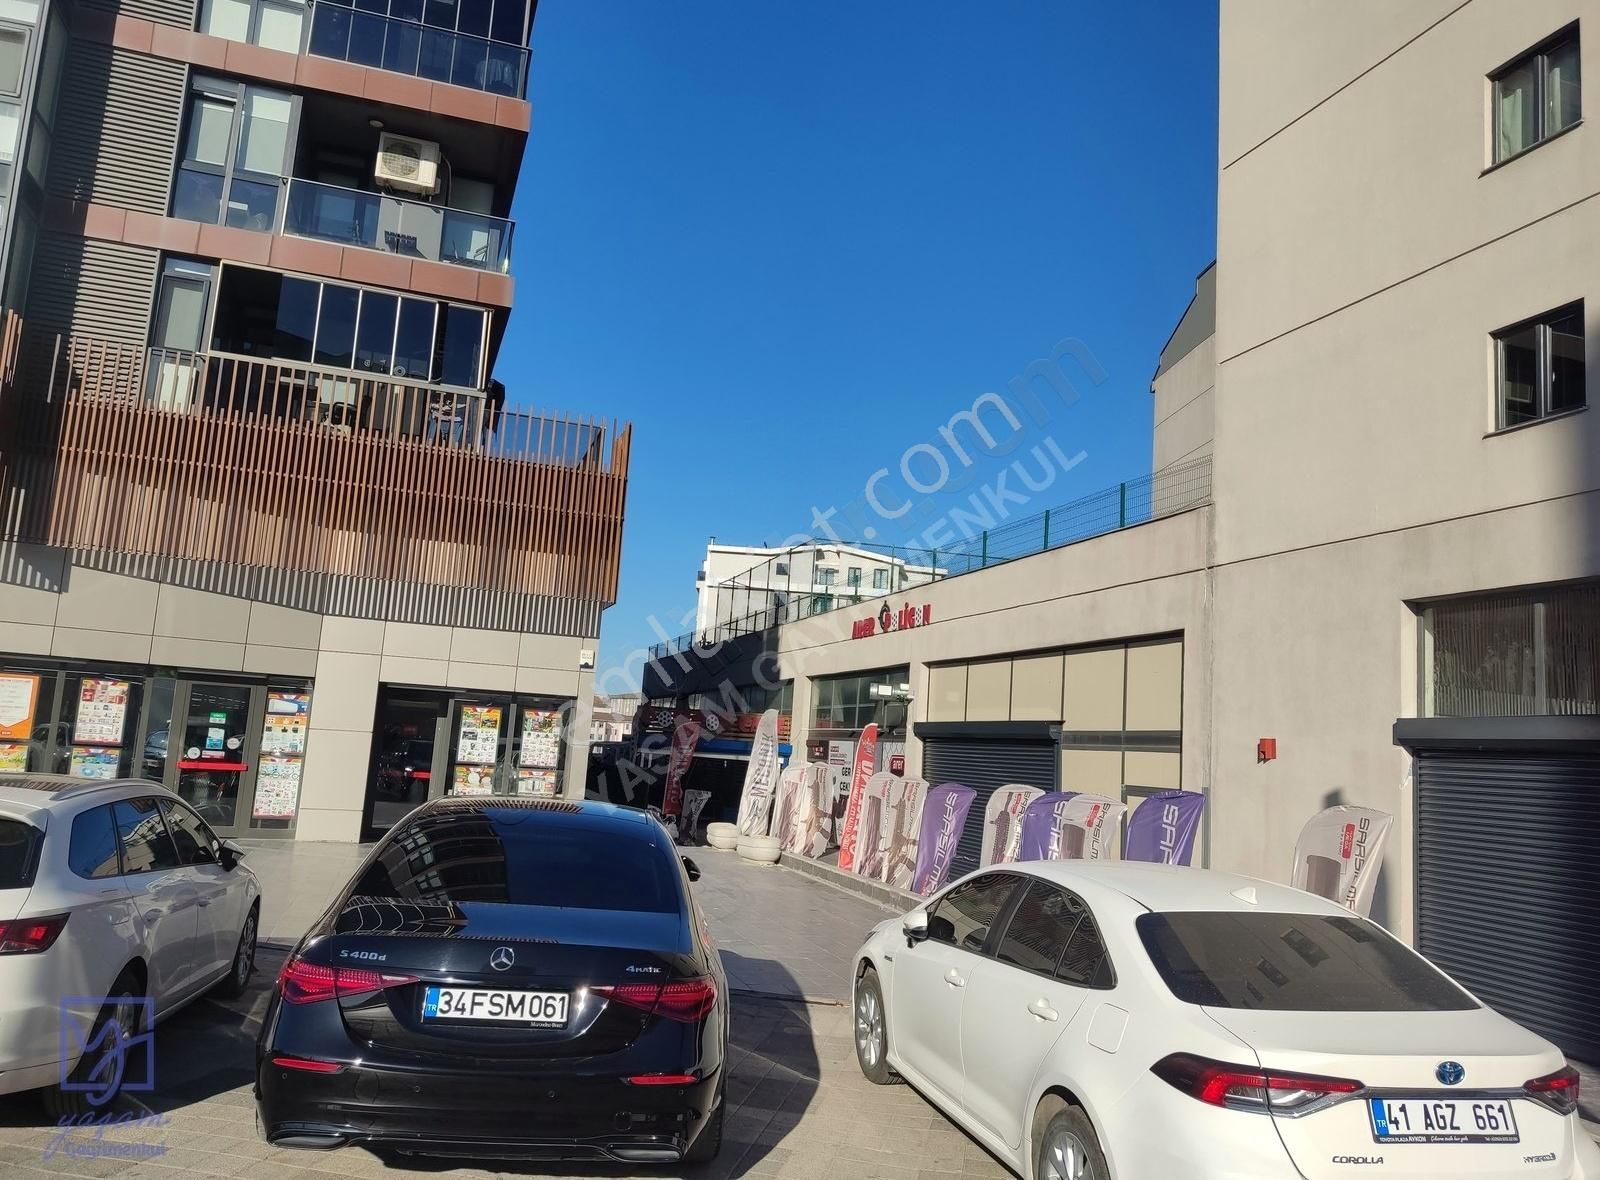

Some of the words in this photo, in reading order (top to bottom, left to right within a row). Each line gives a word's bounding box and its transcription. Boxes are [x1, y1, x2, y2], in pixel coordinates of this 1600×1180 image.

[427, 1004, 437, 1012] TR
[1387, 1103, 1411, 1131] 41
[1423, 1103, 1461, 1131] AGZ
[1472, 1103, 1509, 1131] 661
[1377, 1118, 1388, 1128] TR
[1332, 1155, 1384, 1165] COROLLA
